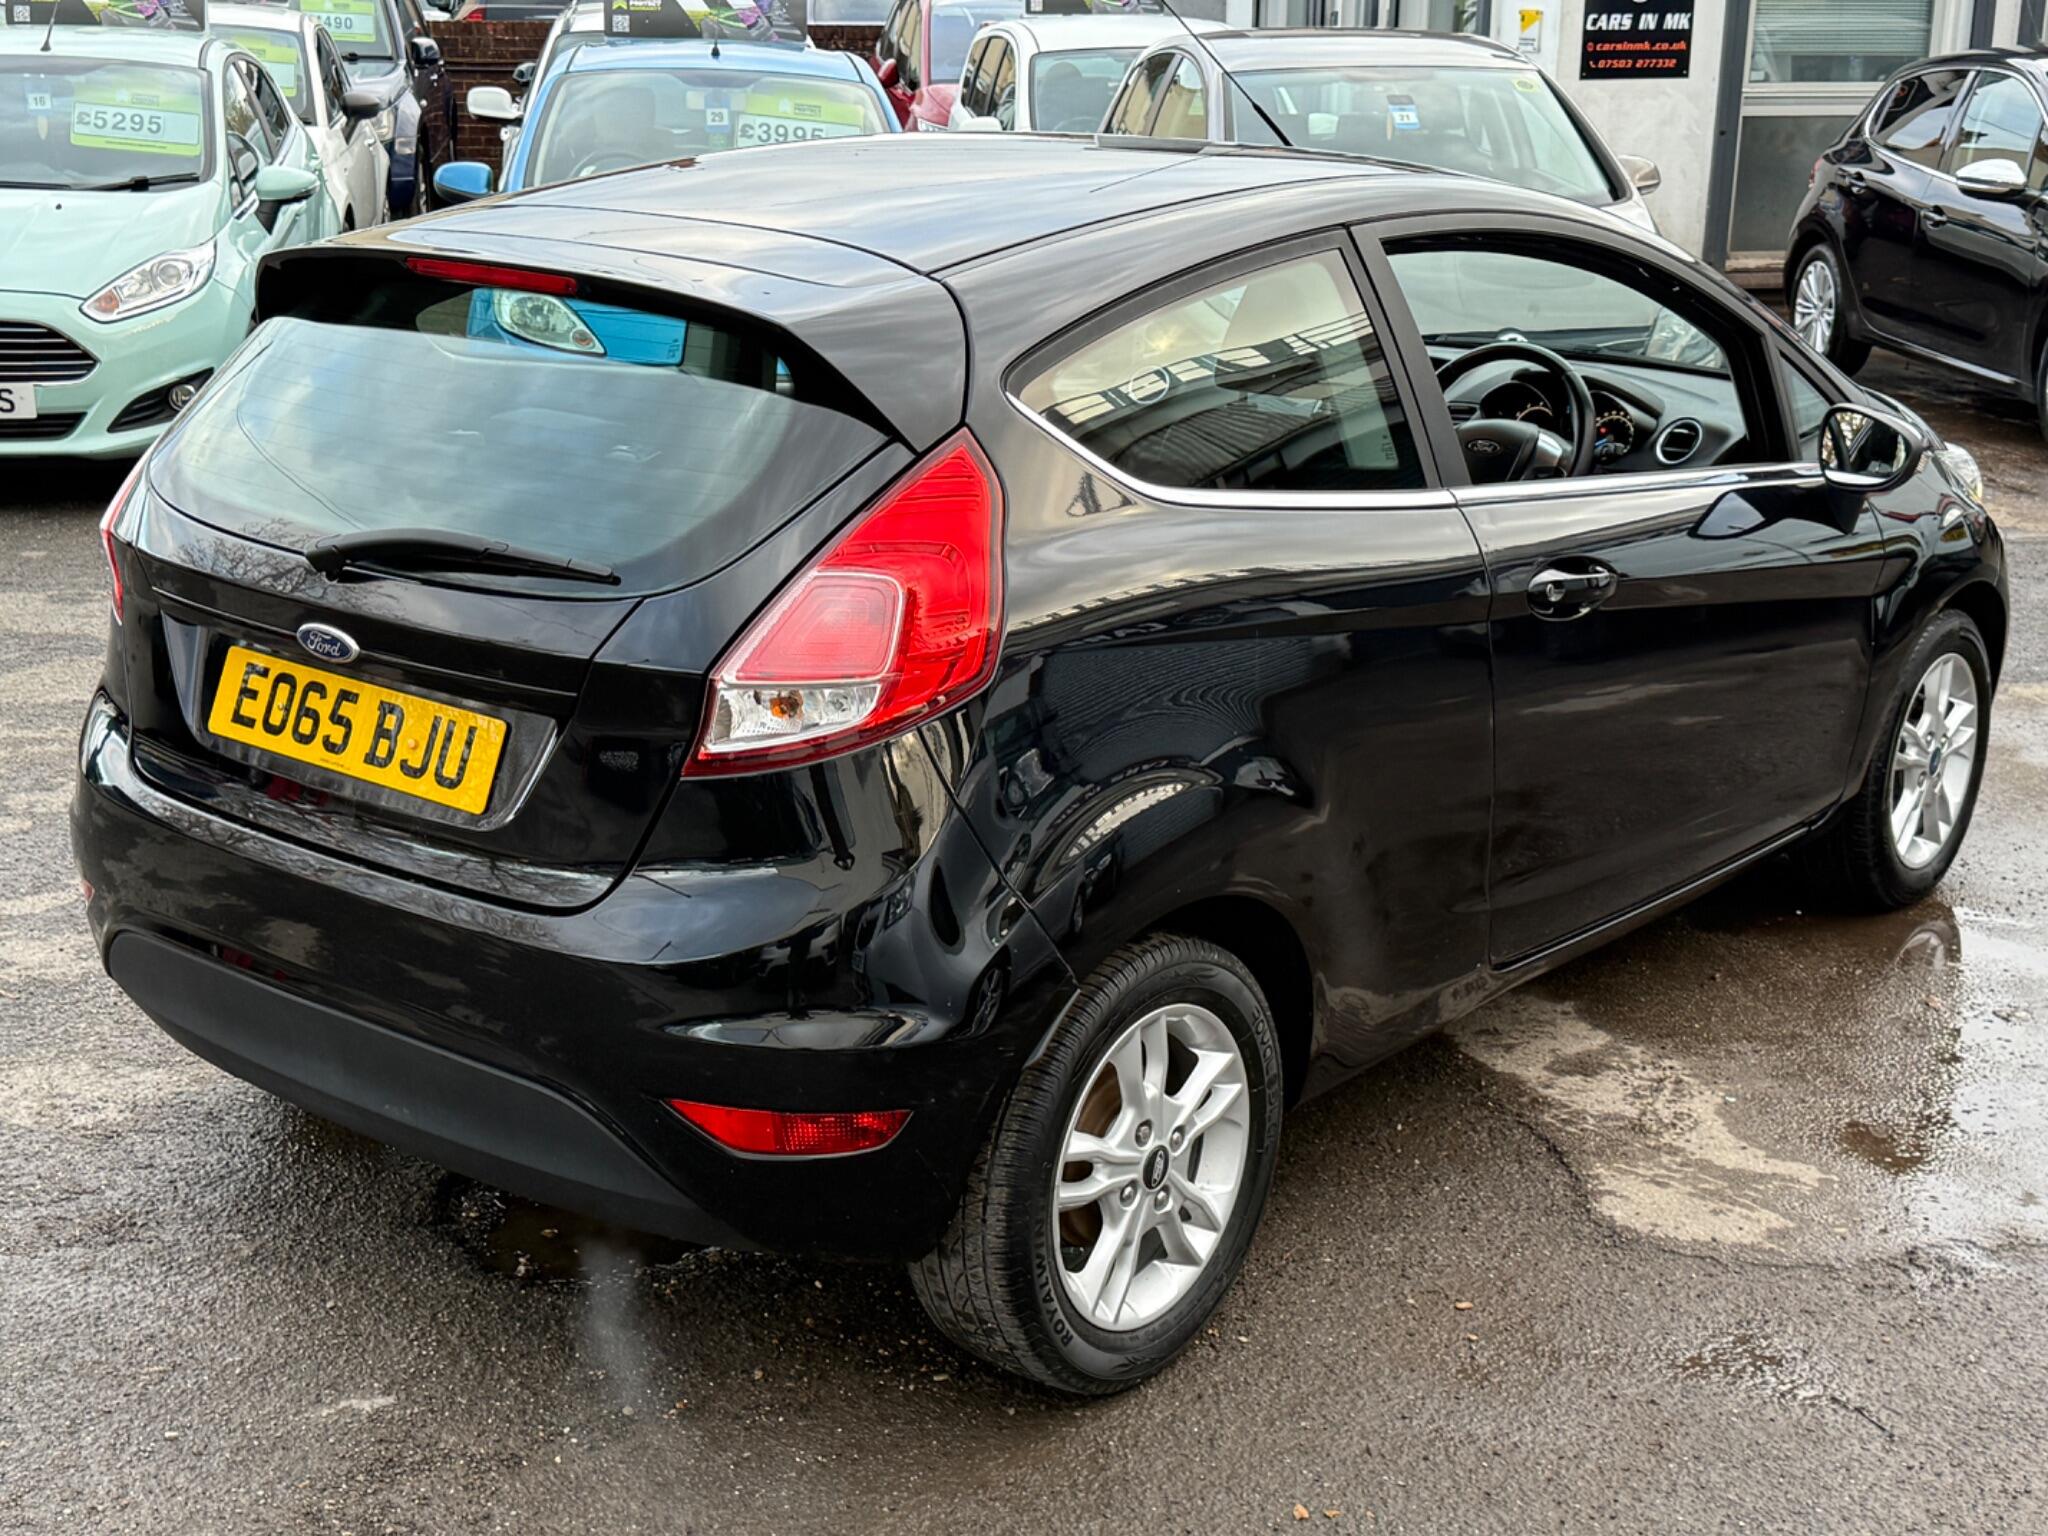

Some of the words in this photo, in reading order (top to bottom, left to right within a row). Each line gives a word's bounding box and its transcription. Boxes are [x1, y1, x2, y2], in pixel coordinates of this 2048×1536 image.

[1586, 13, 1633, 30] CARS
[1638, 13, 1659, 30] IN
[1663, 12, 1691, 30] MK
[1596, 41, 1686, 51] carsinmk.co.uk
[1597, 59, 1633, 68] 07503
[1635, 59, 1677, 68] 277332
[33, 96, 46, 107] 16
[76, 110, 162, 134] £5295
[710, 111, 724, 123] 29
[739, 123, 824, 143] £3995
[307, 630, 341, 656] Ford
[363, 701, 478, 790] BJU
